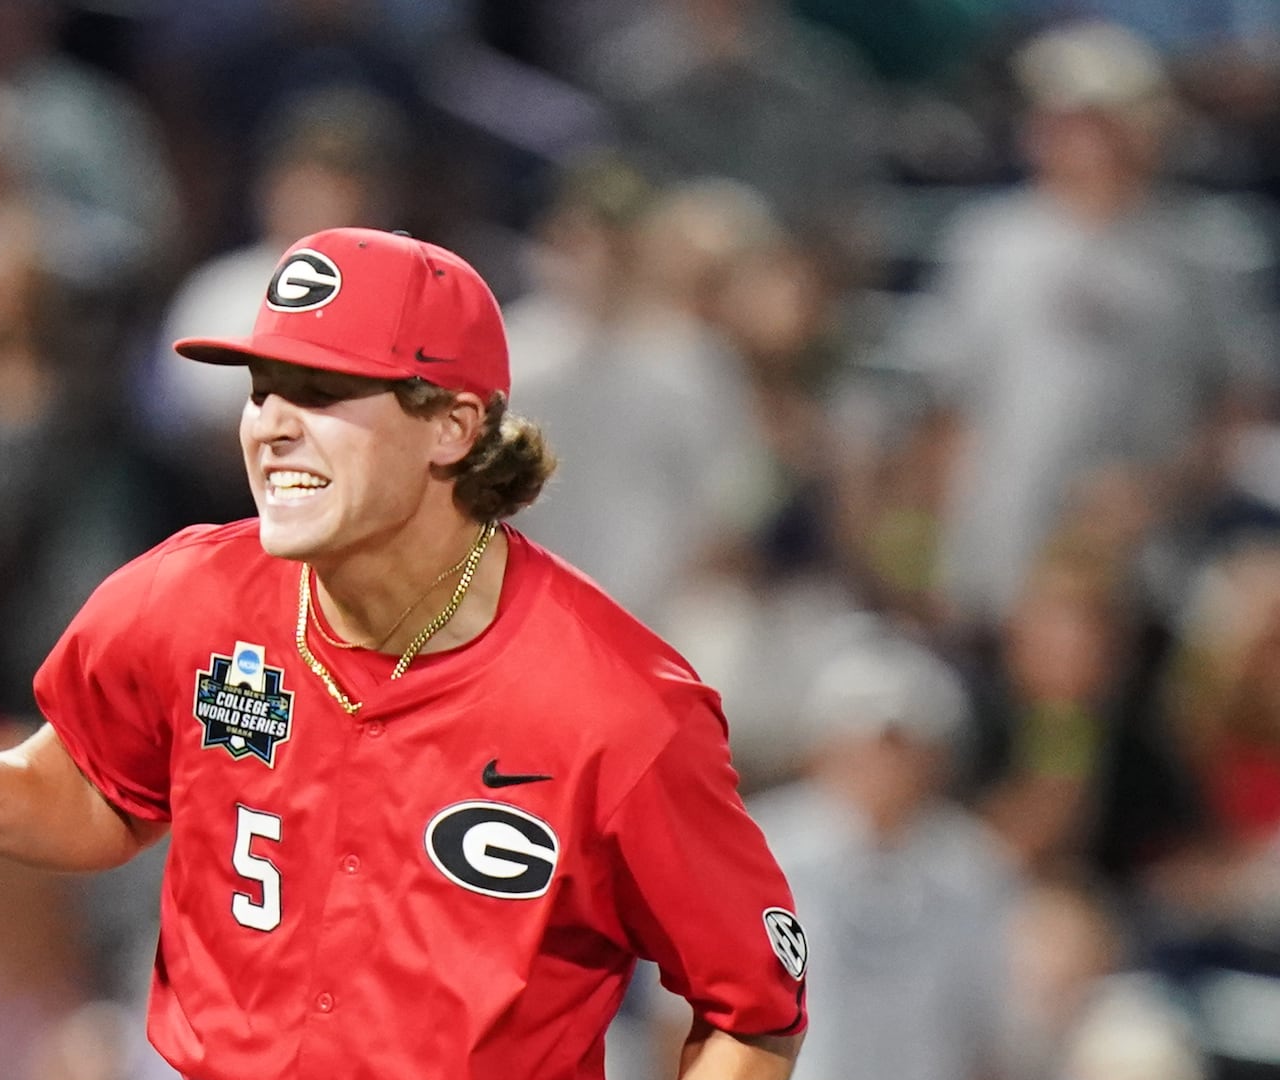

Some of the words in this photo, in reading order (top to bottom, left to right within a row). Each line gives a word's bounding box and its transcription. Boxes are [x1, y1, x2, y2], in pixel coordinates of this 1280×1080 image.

[266, 248, 341, 312] G
[198, 702, 240, 725] WORLD
[241, 714, 287, 737] SERIES
[216, 692, 270, 717] COLLEGE
[226, 726, 252, 738] OMAHA
[232, 804, 282, 931] 5
[424, 799, 560, 900] G
